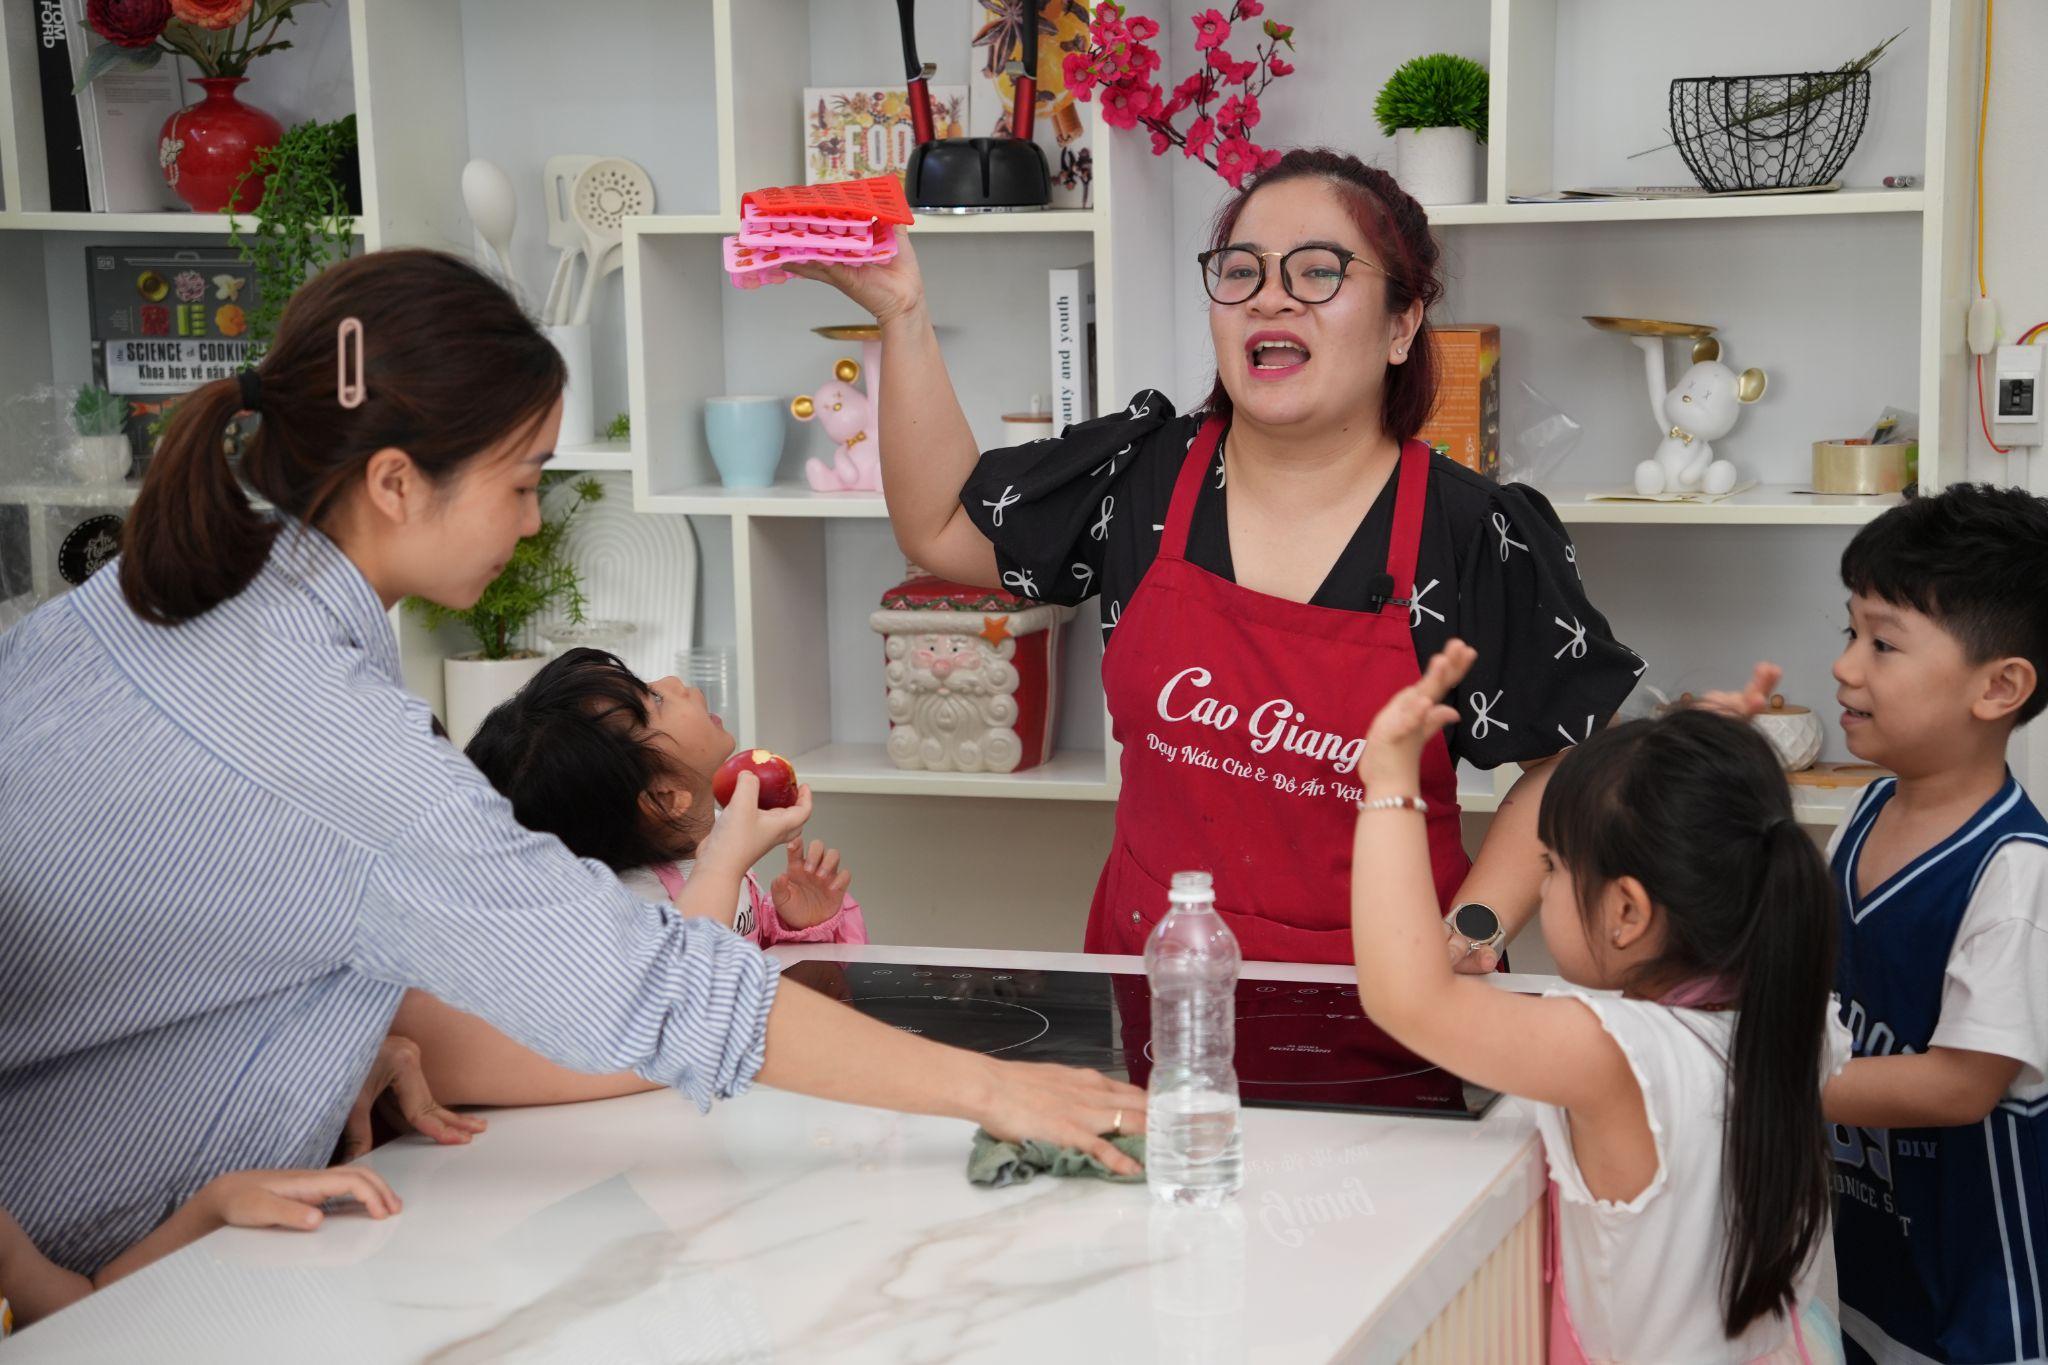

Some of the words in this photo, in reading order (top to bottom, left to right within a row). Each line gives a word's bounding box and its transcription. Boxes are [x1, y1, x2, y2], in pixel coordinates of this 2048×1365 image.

[40, 1, 55, 48] FORD
[52, 0, 66, 40] TOM
[844, 123, 914, 172] FOO
[1056, 296, 1072, 343] youth
[126, 342, 182, 361] SCIENCE
[138, 364, 165, 380] Khoa
[1058, 350, 1071, 380] and
[1061, 386, 1074, 425] auty
[1156, 666, 1239, 731] Cao
[1248, 698, 1368, 774] Giang
[1146, 733, 1178, 763] Dạy
[1181, 745, 1220, 770] Nấu
[1221, 757, 1253, 779] Chè
[1254, 767, 1269, 782] &
[1272, 773, 1298, 793] Đồ
[1298, 777, 1327, 797] Ăn
[1330, 781, 1364, 802] Vặt
